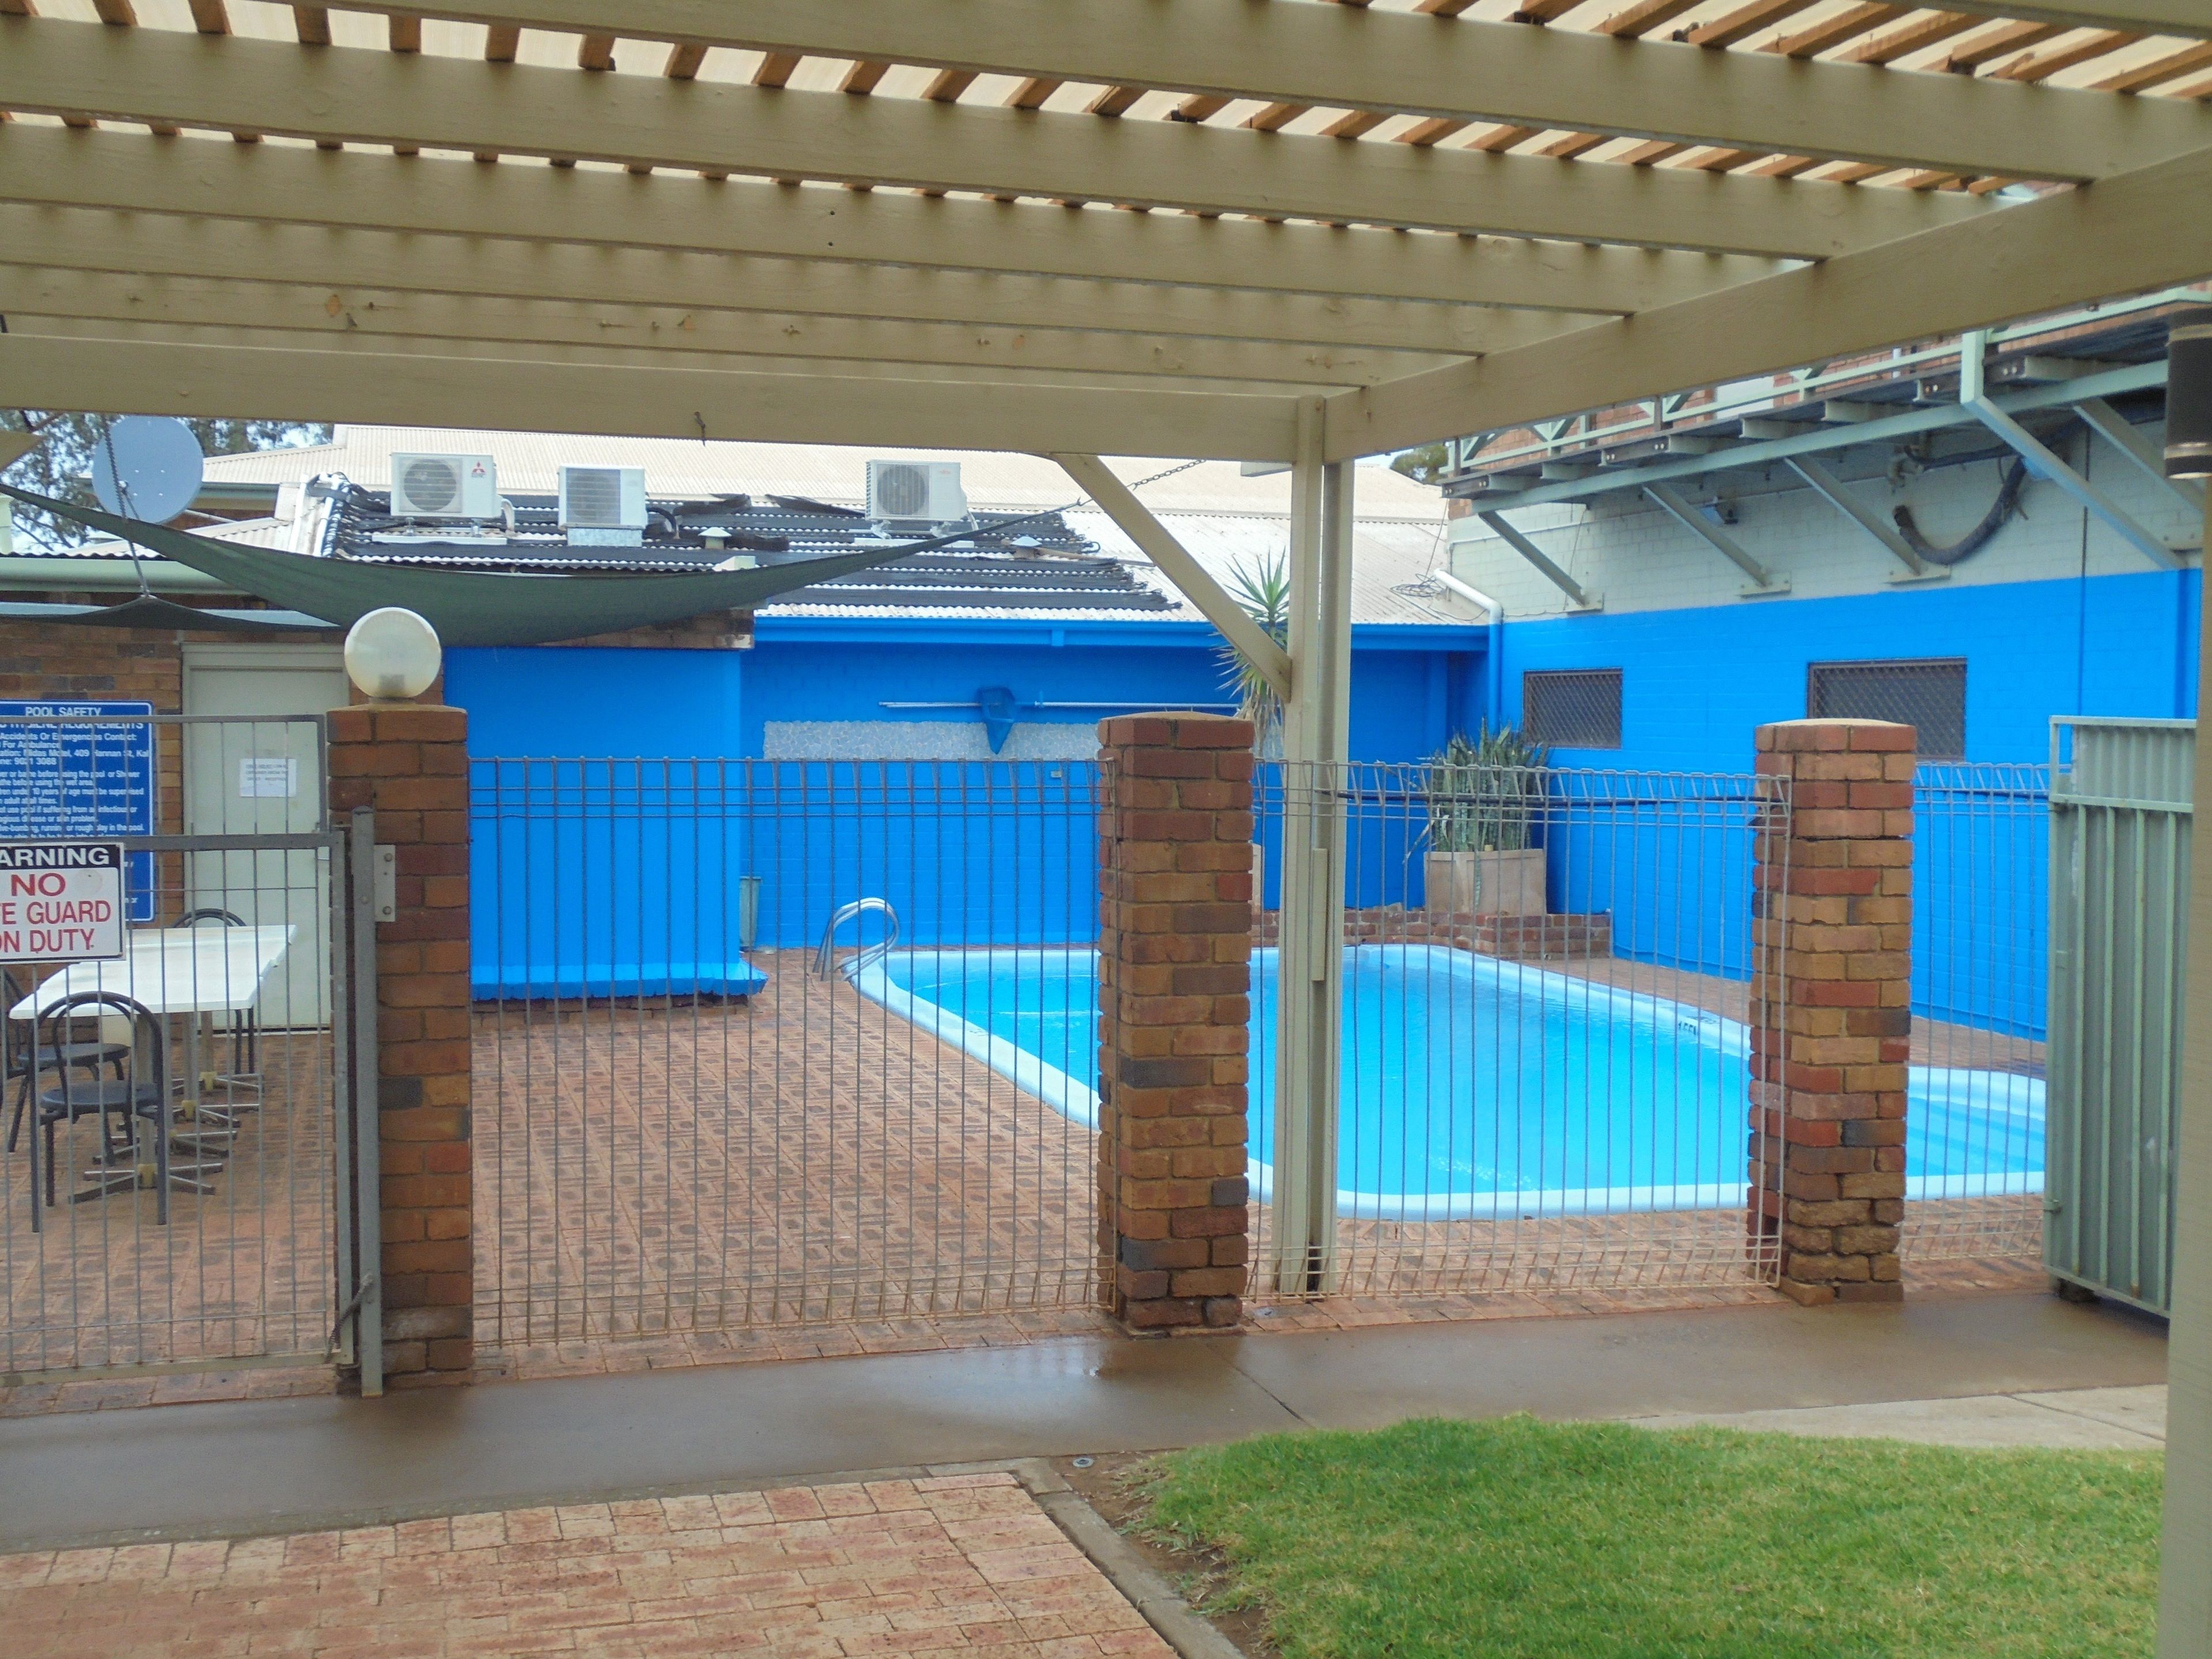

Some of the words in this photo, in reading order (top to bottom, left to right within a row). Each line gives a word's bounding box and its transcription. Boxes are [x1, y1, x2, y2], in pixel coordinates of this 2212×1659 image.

[25, 706, 57, 717] POOL
[59, 707, 101, 717] SAFETY
[39, 732, 50, 740] Or
[10, 872, 66, 897] NO
[26, 900, 111, 925] GUARD
[29, 928, 95, 953] DUTY
